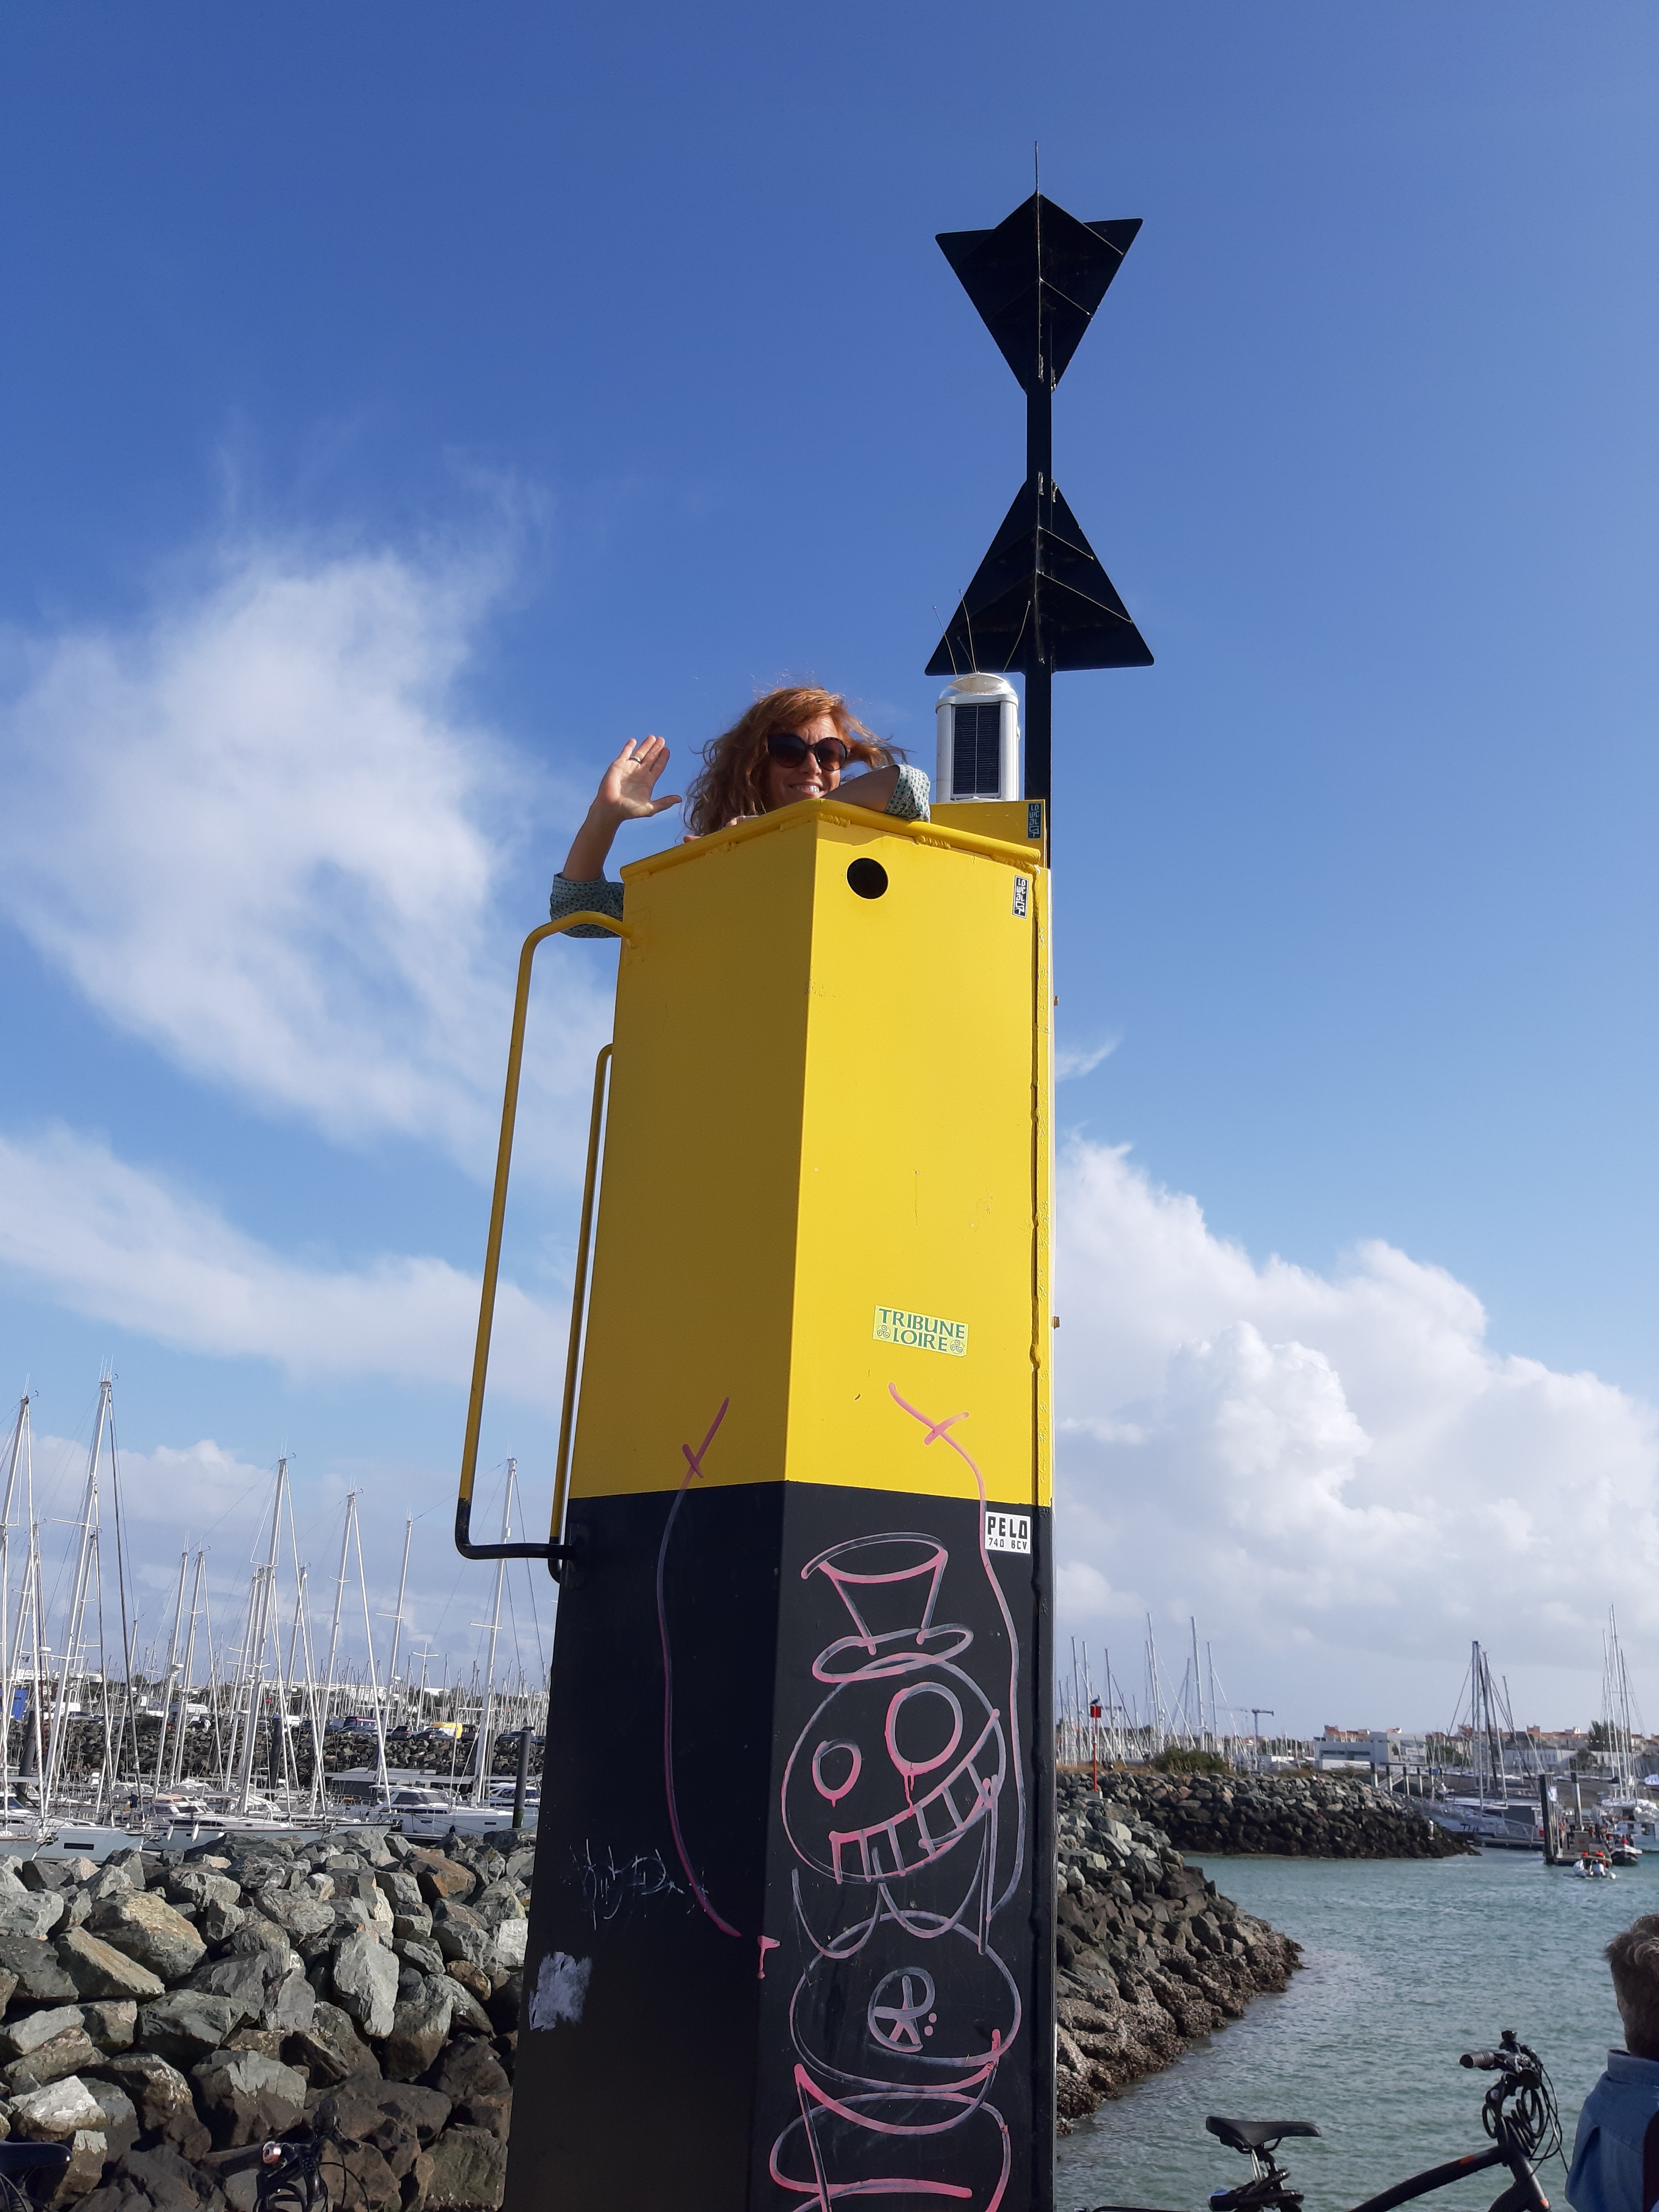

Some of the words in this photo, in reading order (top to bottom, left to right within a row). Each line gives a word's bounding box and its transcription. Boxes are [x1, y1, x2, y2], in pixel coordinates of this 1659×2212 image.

[879, 1308, 965, 1339] TRIBUNE
[893, 1327, 948, 1352] LOIRE
[987, 1516, 1028, 1539] PELO
[988, 1538, 1004, 1548] 740
[1011, 1540, 1028, 1550] BCV
